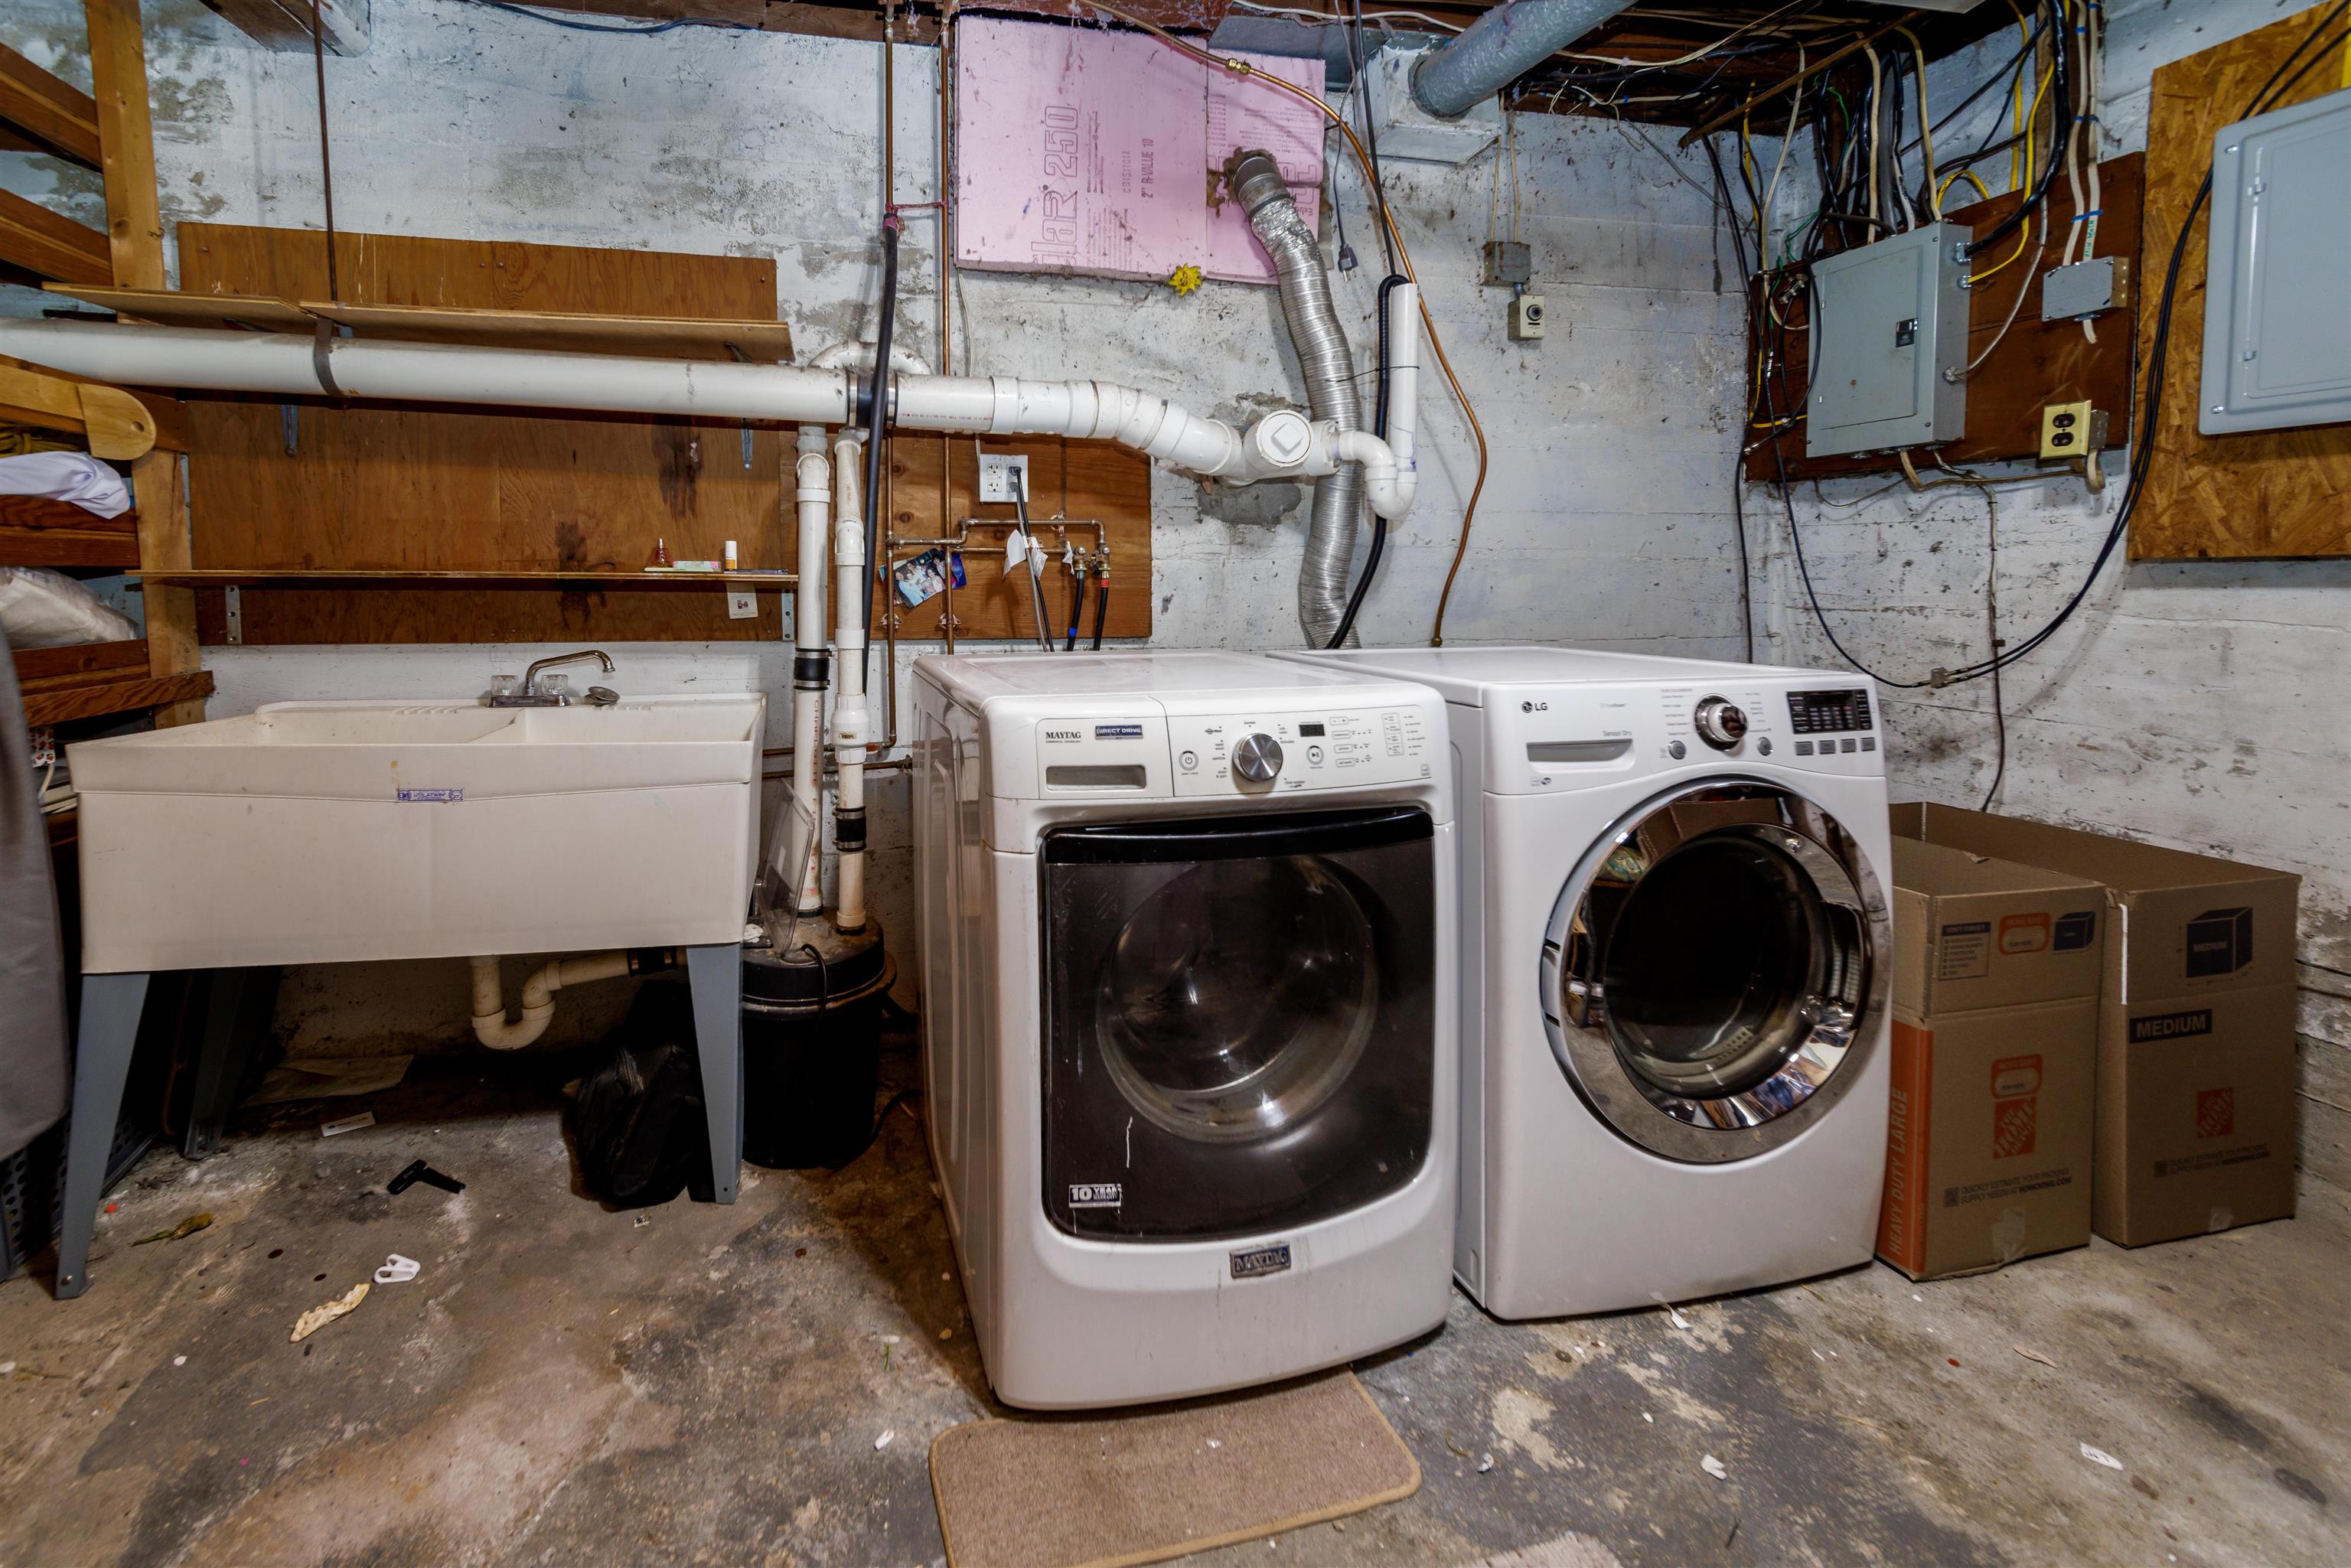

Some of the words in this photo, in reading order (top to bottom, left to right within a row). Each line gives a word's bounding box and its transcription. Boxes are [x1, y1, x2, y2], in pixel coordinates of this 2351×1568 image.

[1044, 106, 1078, 178] 250
[1141, 138, 1153, 148] 10
[1141, 152, 1153, 184] R-VALUE
[1534, 702, 1548, 711] LG
[2193, 940, 2228, 953] MEDIUM
[2136, 1014, 2207, 1038] MEDIUM
[1889, 1087, 1908, 1154] LARGE
[1891, 1156, 1905, 1201] DUTY
[1071, 1188, 1092, 1201] 10
[1889, 1205, 1903, 1257] HEAVY
